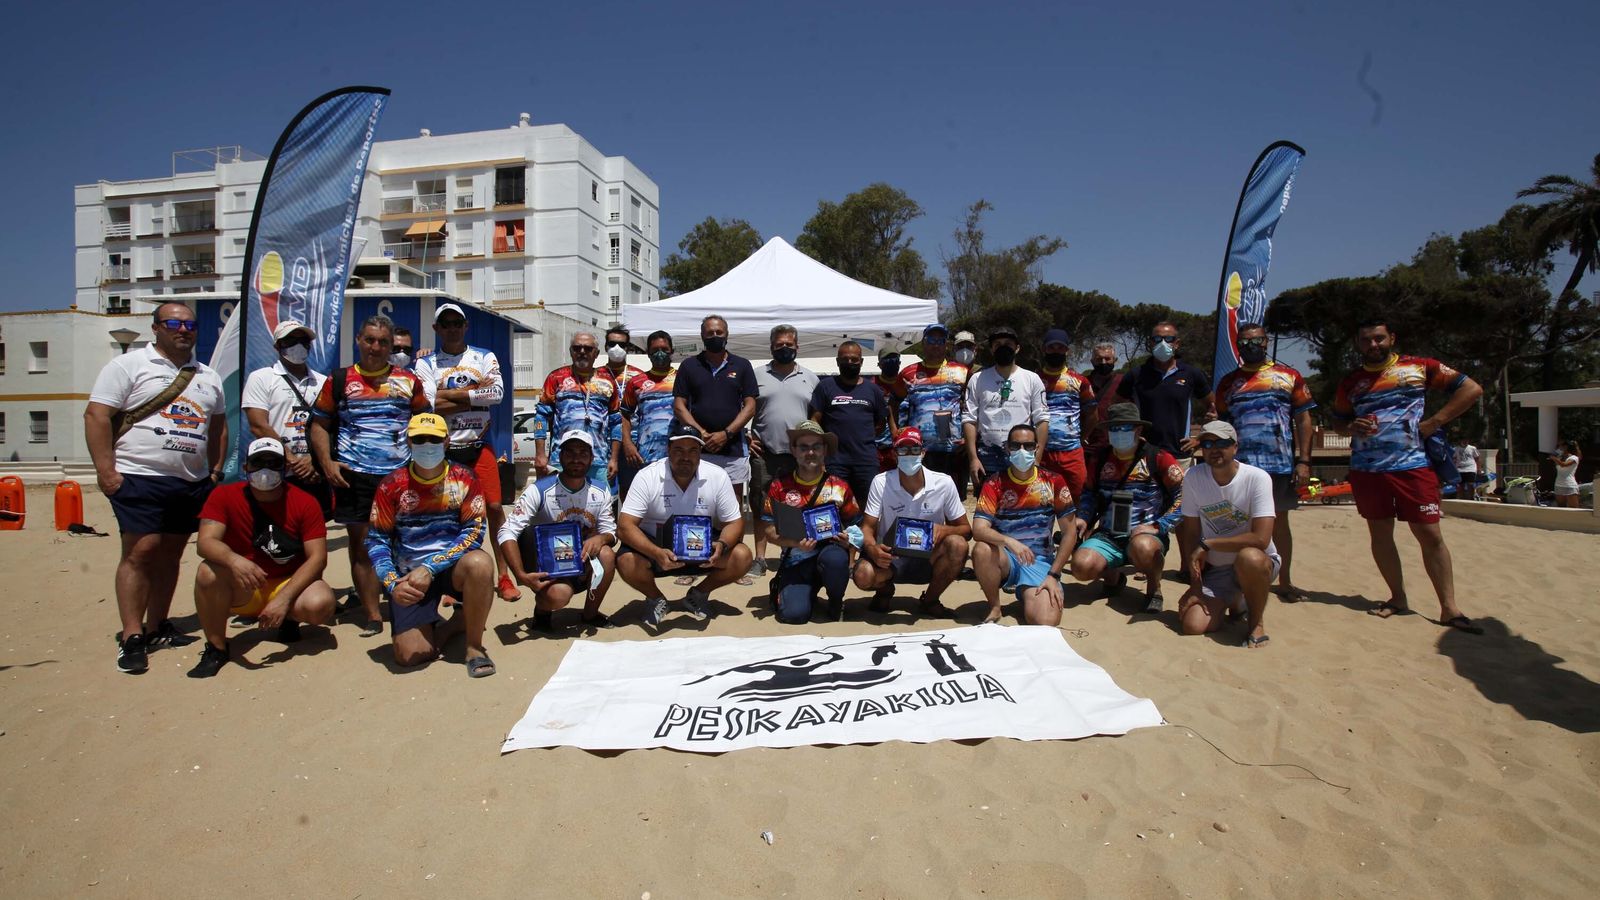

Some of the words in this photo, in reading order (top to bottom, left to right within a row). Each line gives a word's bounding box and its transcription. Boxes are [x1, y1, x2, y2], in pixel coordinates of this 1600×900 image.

[326, 281, 341, 345] Servicio
[335, 197, 356, 277] Municipal
[351, 174, 361, 195] de
[653, 673, 1016, 741] PESKAYAKISLA
